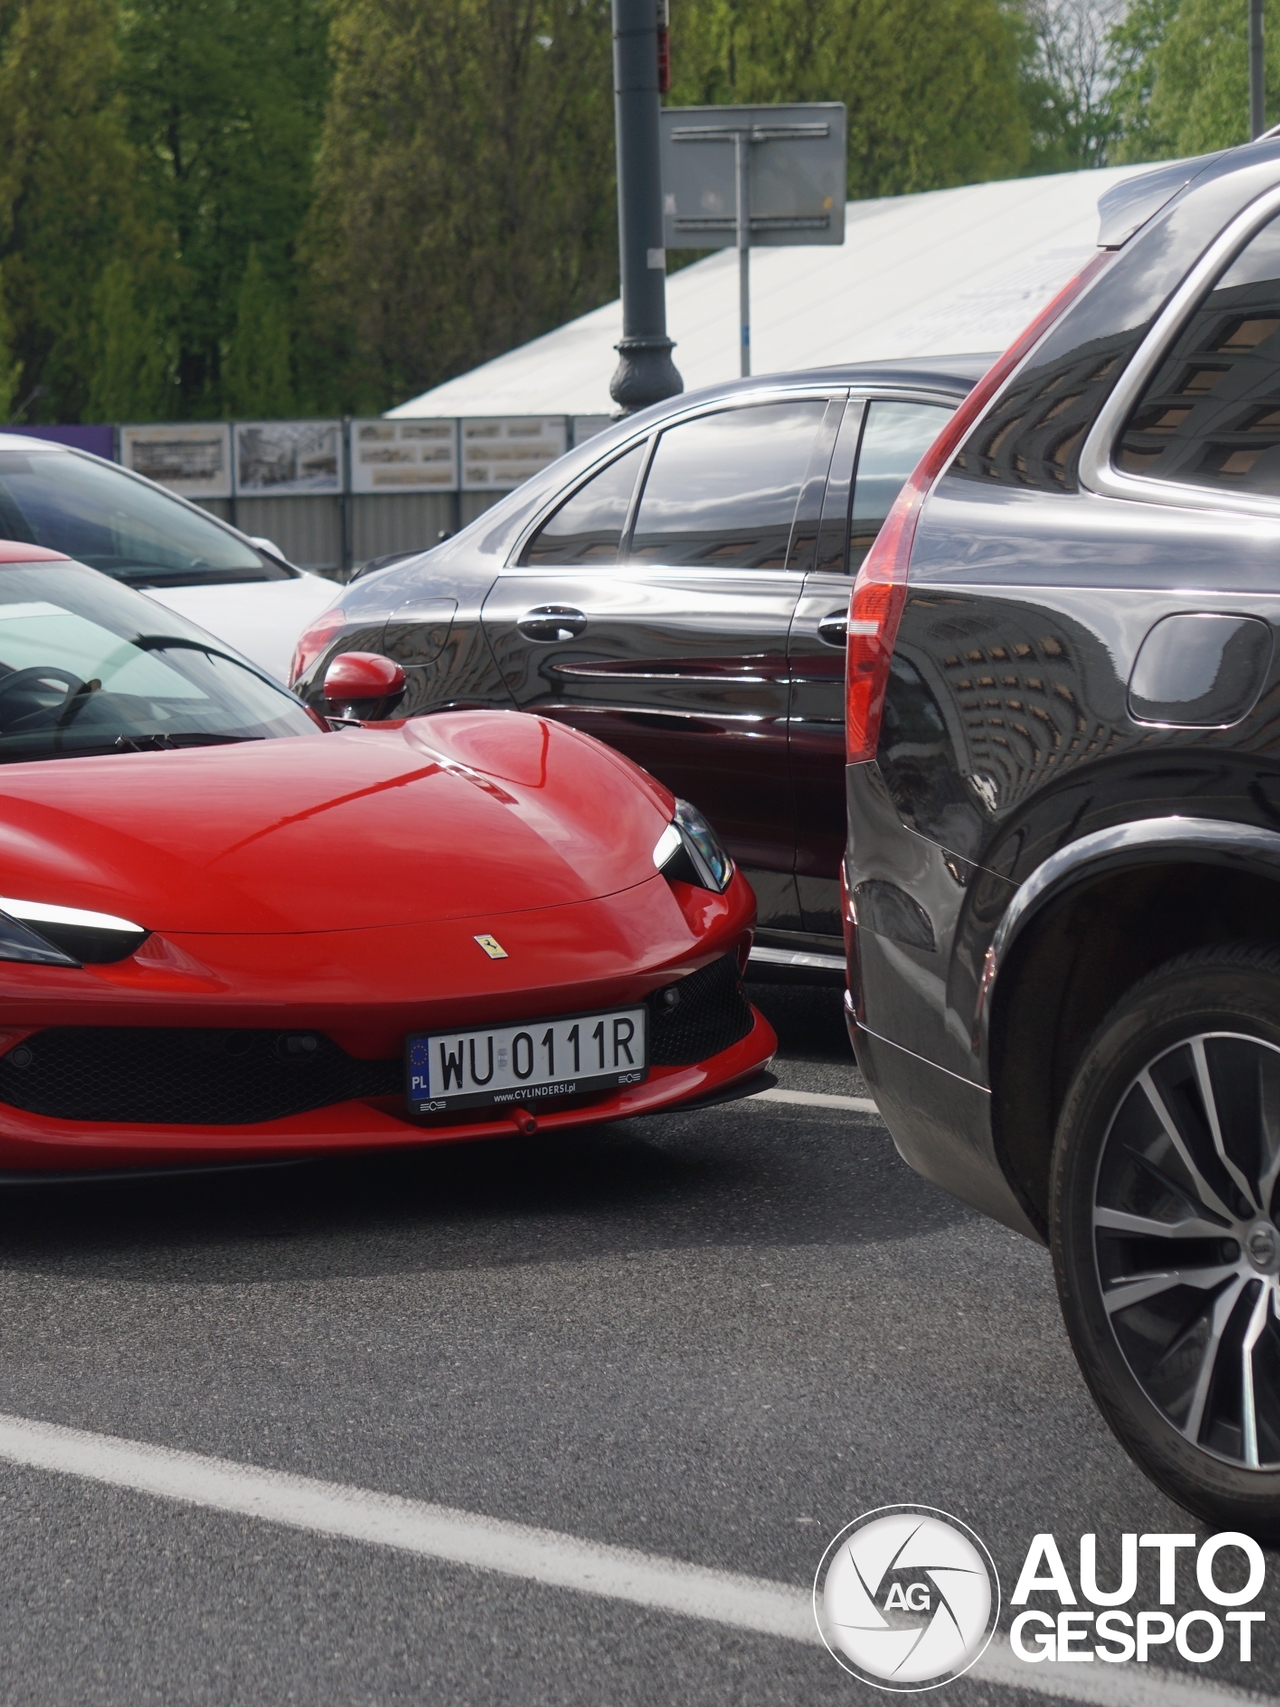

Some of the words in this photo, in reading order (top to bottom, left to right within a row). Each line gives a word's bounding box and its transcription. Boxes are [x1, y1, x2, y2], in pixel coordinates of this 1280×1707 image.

[439, 1035, 494, 1091] WU
[512, 1017, 635, 1080] 0111R
[411, 1075, 427, 1090] PL
